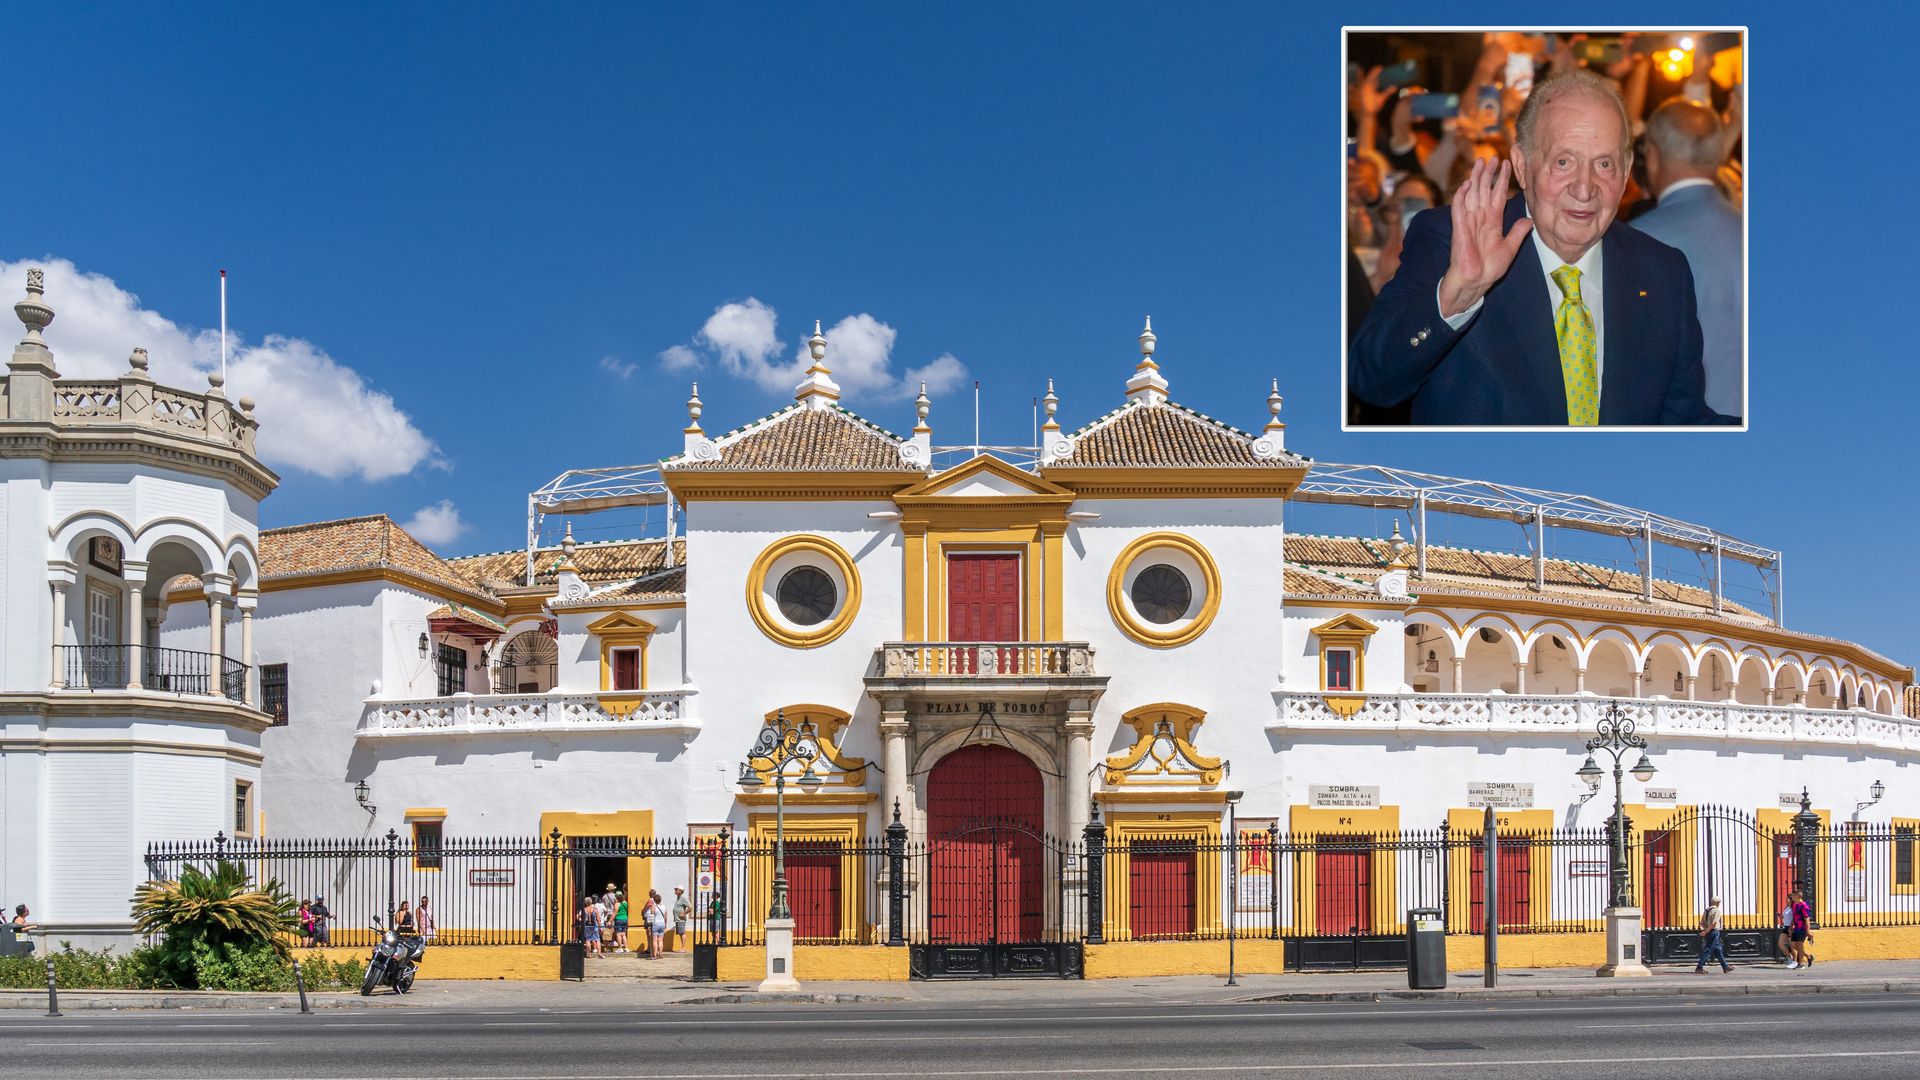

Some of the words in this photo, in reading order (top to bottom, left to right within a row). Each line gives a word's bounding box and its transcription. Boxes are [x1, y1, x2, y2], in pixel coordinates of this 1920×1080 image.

[925, 702, 970, 713] PLAZA
[1003, 702, 1046, 714] TOROS
[1645, 791, 1677, 799] TAQUILLAS
[1347, 817, 1352, 825] 4
[1504, 818, 1509, 826] 6
